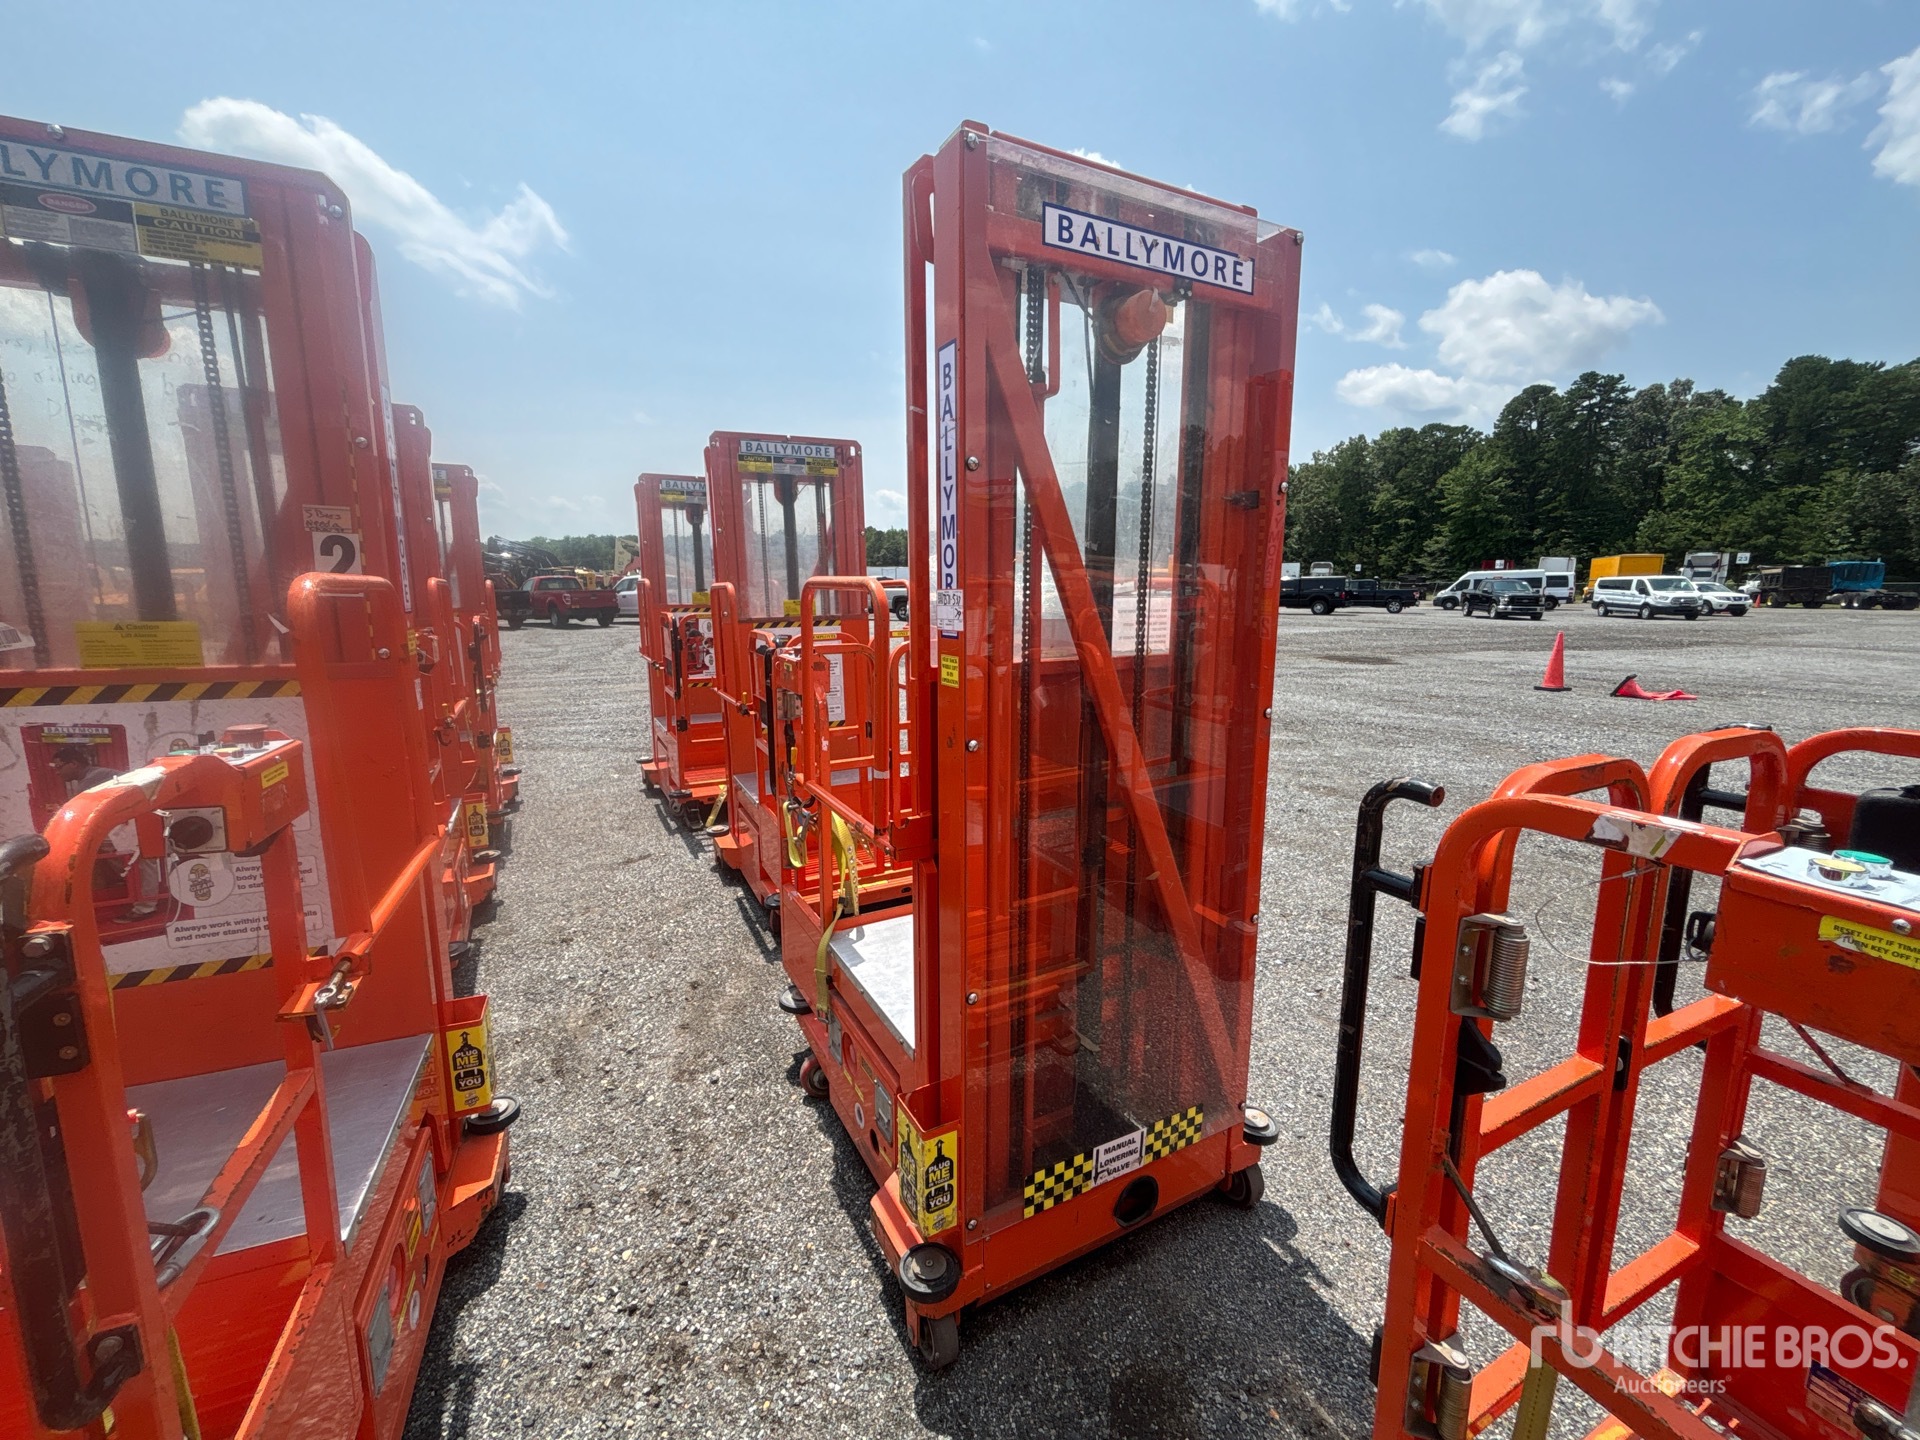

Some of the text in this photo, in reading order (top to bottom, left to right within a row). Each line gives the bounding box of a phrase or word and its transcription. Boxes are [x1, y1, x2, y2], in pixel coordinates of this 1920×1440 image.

[160, 208, 234, 228] BALLYMORE
[153, 218, 245, 240] CAUTION
[1058, 213, 1244, 287] BALLYMORE
[745, 441, 831, 457] BALLYMORE
[320, 534, 356, 573] 2
[236, 873, 258, 882] body
[174, 923, 208, 934] Always
[209, 921, 232, 930] work
[233, 916, 261, 926] within
[175, 932, 193, 942] and
[194, 929, 220, 939] never
[222, 926, 248, 936] stand
[1833, 924, 1862, 937] RESET
[1864, 933, 1885, 944] LIFT
[1886, 939, 1895, 947] IF
[1842, 935, 1869, 949] TURN
[1870, 944, 1890, 955] KEY
[1891, 950, 1912, 961] OFF
[455, 1049, 479, 1058] PLUG
[456, 1055, 479, 1066] ME
[459, 1077, 482, 1087] YOU
[1103, 1137, 1137, 1156] MANUAL
[928, 1160, 951, 1173] PLUG
[1099, 1147, 1139, 1169] LOWERING
[928, 1166, 951, 1183] ME
[1106, 1161, 1131, 1176] VALVE
[929, 1194, 951, 1208] YOU
